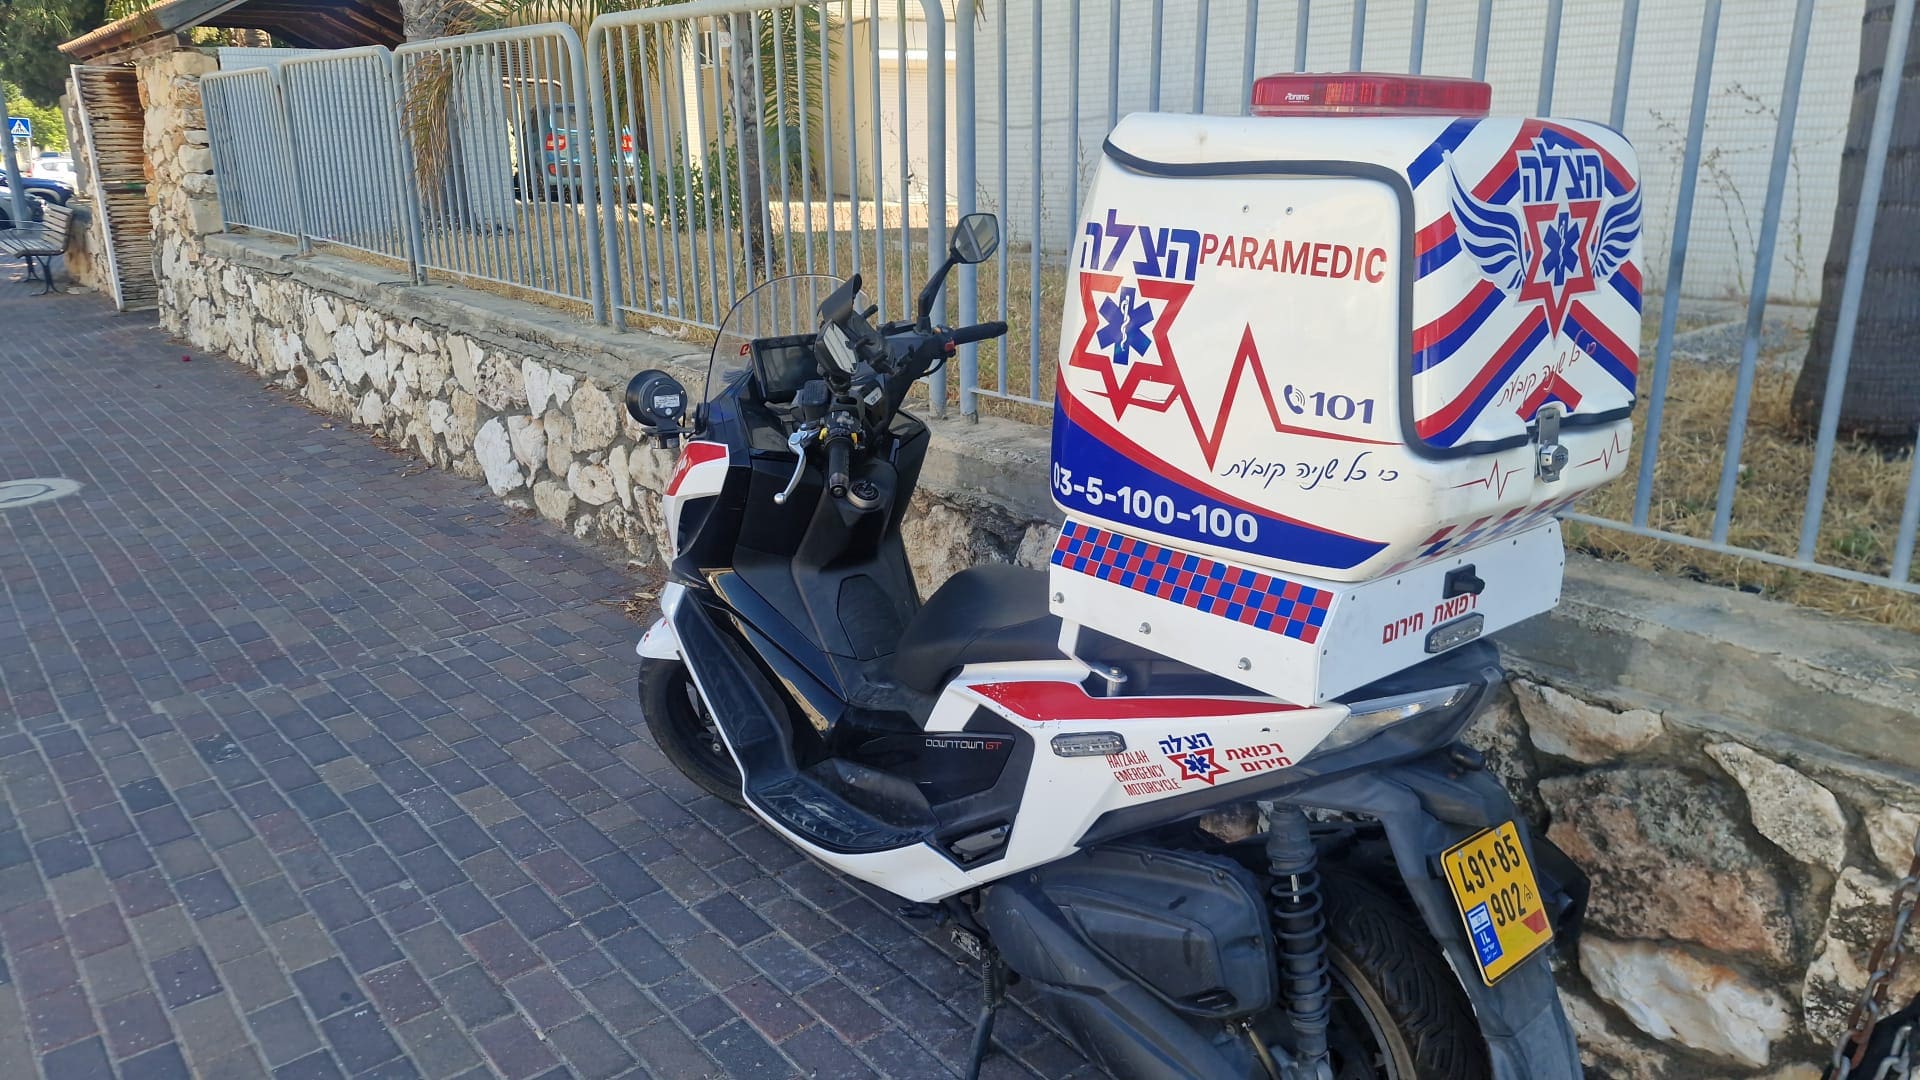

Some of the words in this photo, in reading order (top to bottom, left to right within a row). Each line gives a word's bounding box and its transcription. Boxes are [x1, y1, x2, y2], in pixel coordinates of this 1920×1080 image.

[1520, 142, 1604, 203] הצלה
[1080, 208, 1201, 281] הצלה
[1200, 233, 1388, 283] PARAMEDIC
[1309, 391, 1375, 425] 101
[1220, 457, 1286, 489] קובעת
[1296, 458, 1339, 491] שניה
[1343, 451, 1373, 482] כל
[1378, 469, 1399, 482] כי
[1053, 461, 1259, 543] 03-5-100-100
[1432, 594, 1477, 625] רפואת
[1382, 612, 1424, 644] חירום
[925, 739, 984, 750] DOWNTOWN
[985, 741, 1002, 750] GT
[1158, 732, 1213, 755] הצלה
[1224, 743, 1284, 761] רפואת
[1105, 750, 1150, 769] HATZALAH
[1113, 763, 1166, 783] EMERGENCY
[1240, 757, 1292, 773] חירום
[1123, 778, 1182, 797] MOTORCYCLE
[1457, 833, 1521, 895] 491-85
[1490, 882, 1527, 927] 902
